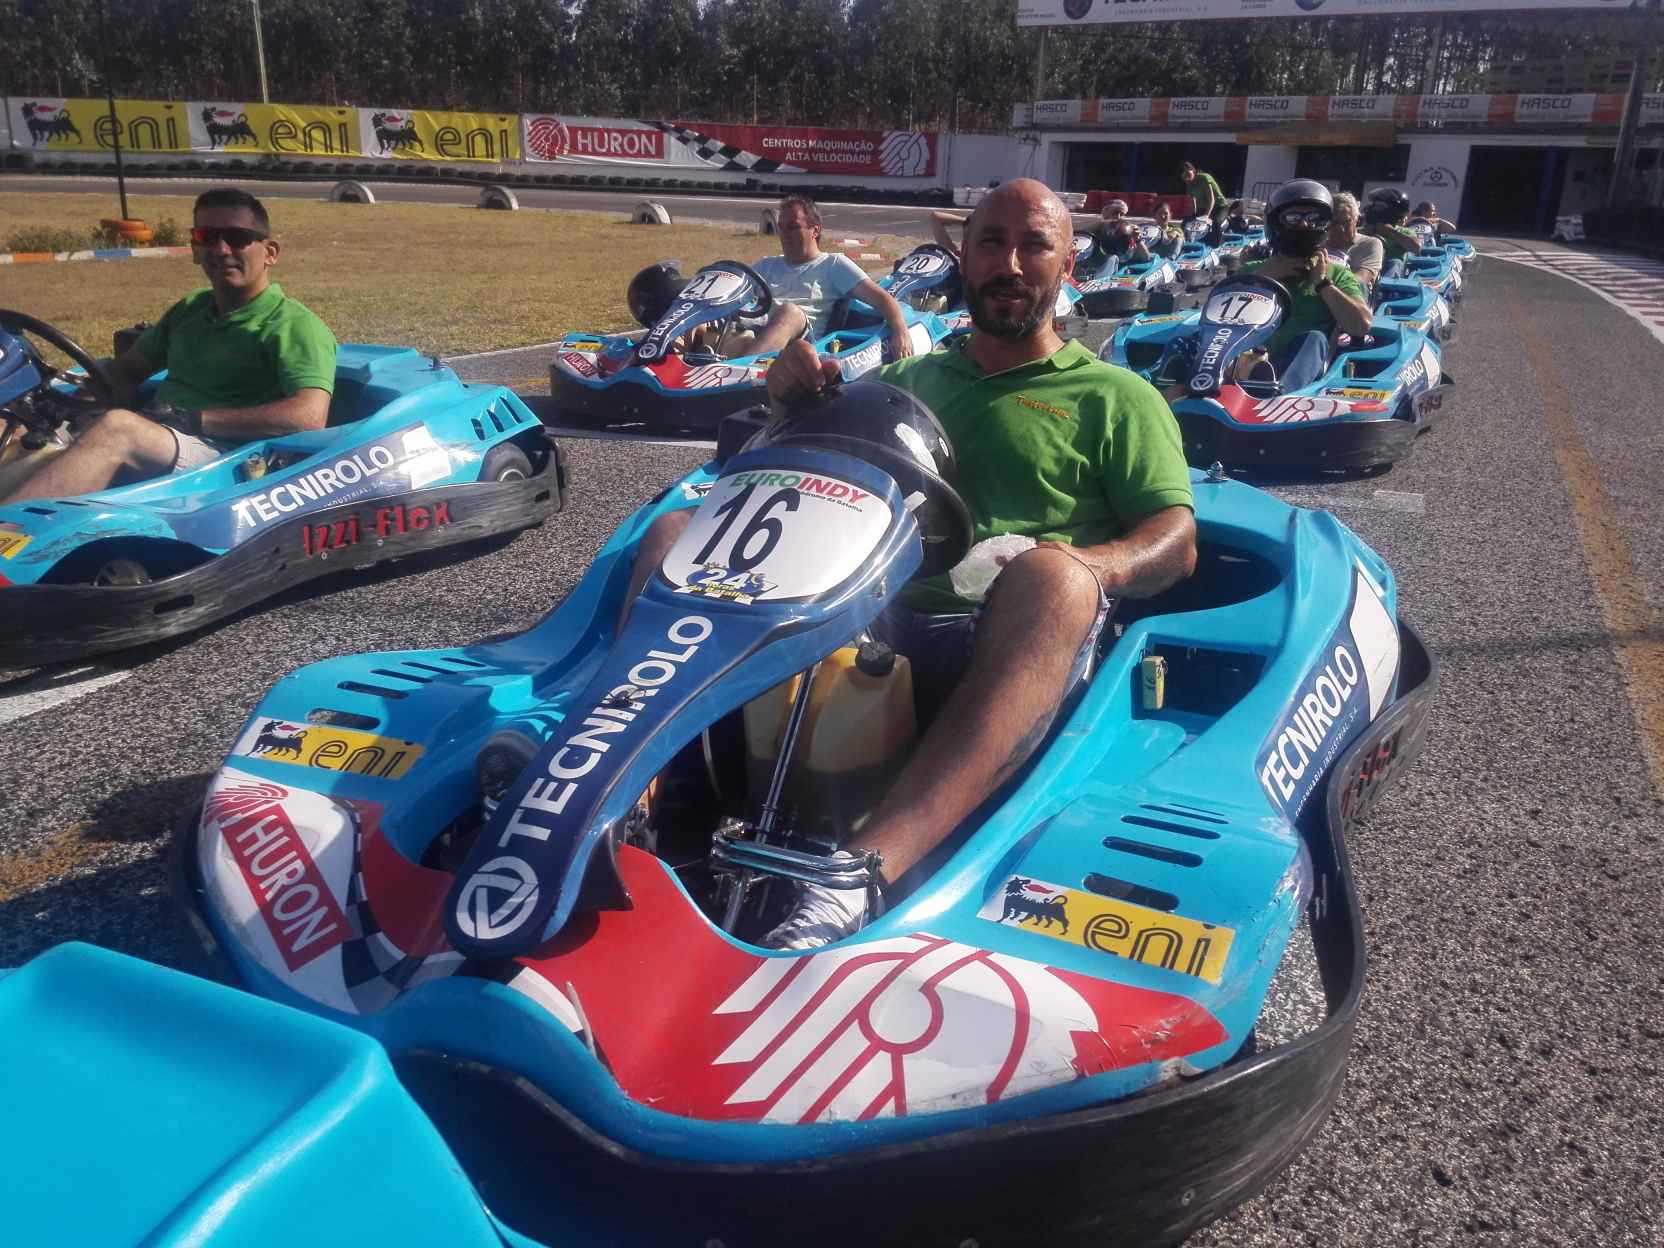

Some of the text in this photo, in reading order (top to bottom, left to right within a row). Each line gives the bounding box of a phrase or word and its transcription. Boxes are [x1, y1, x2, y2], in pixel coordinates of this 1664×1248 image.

[1036, 103, 1067, 113] HASCO
[1102, 102, 1136, 112] HASCO
[1172, 100, 1209, 111] HASCO
[1249, 99, 1289, 110] HASCO
[1332, 98, 1376, 110] HASCO
[1422, 98, 1470, 109] HASCO
[1520, 97, 1572, 109] HASCO
[94, 105, 179, 149] eni
[270, 109, 349, 153] eni
[435, 117, 509, 160] eni
[577, 130, 656, 155] HURON
[762, 137, 874, 151] CENTROS MAQUINAÇÃO
[785, 152, 872, 164] ALTA VELOCIDADE
[905, 256, 929, 273] 20
[683, 273, 719, 295] 21
[1220, 296, 1252, 321] 17
[566, 354, 596, 377] HURON
[232, 445, 395, 529] TECNIROLO
[692, 482, 801, 573] 16
[697, 568, 751, 590] 24
[497, 615, 714, 848] TECNIROLO
[1262, 645, 1358, 810] TECNIROLO
[309, 740, 414, 778] eni
[235, 814, 338, 954] HURON
[1083, 912, 1217, 977] eni
